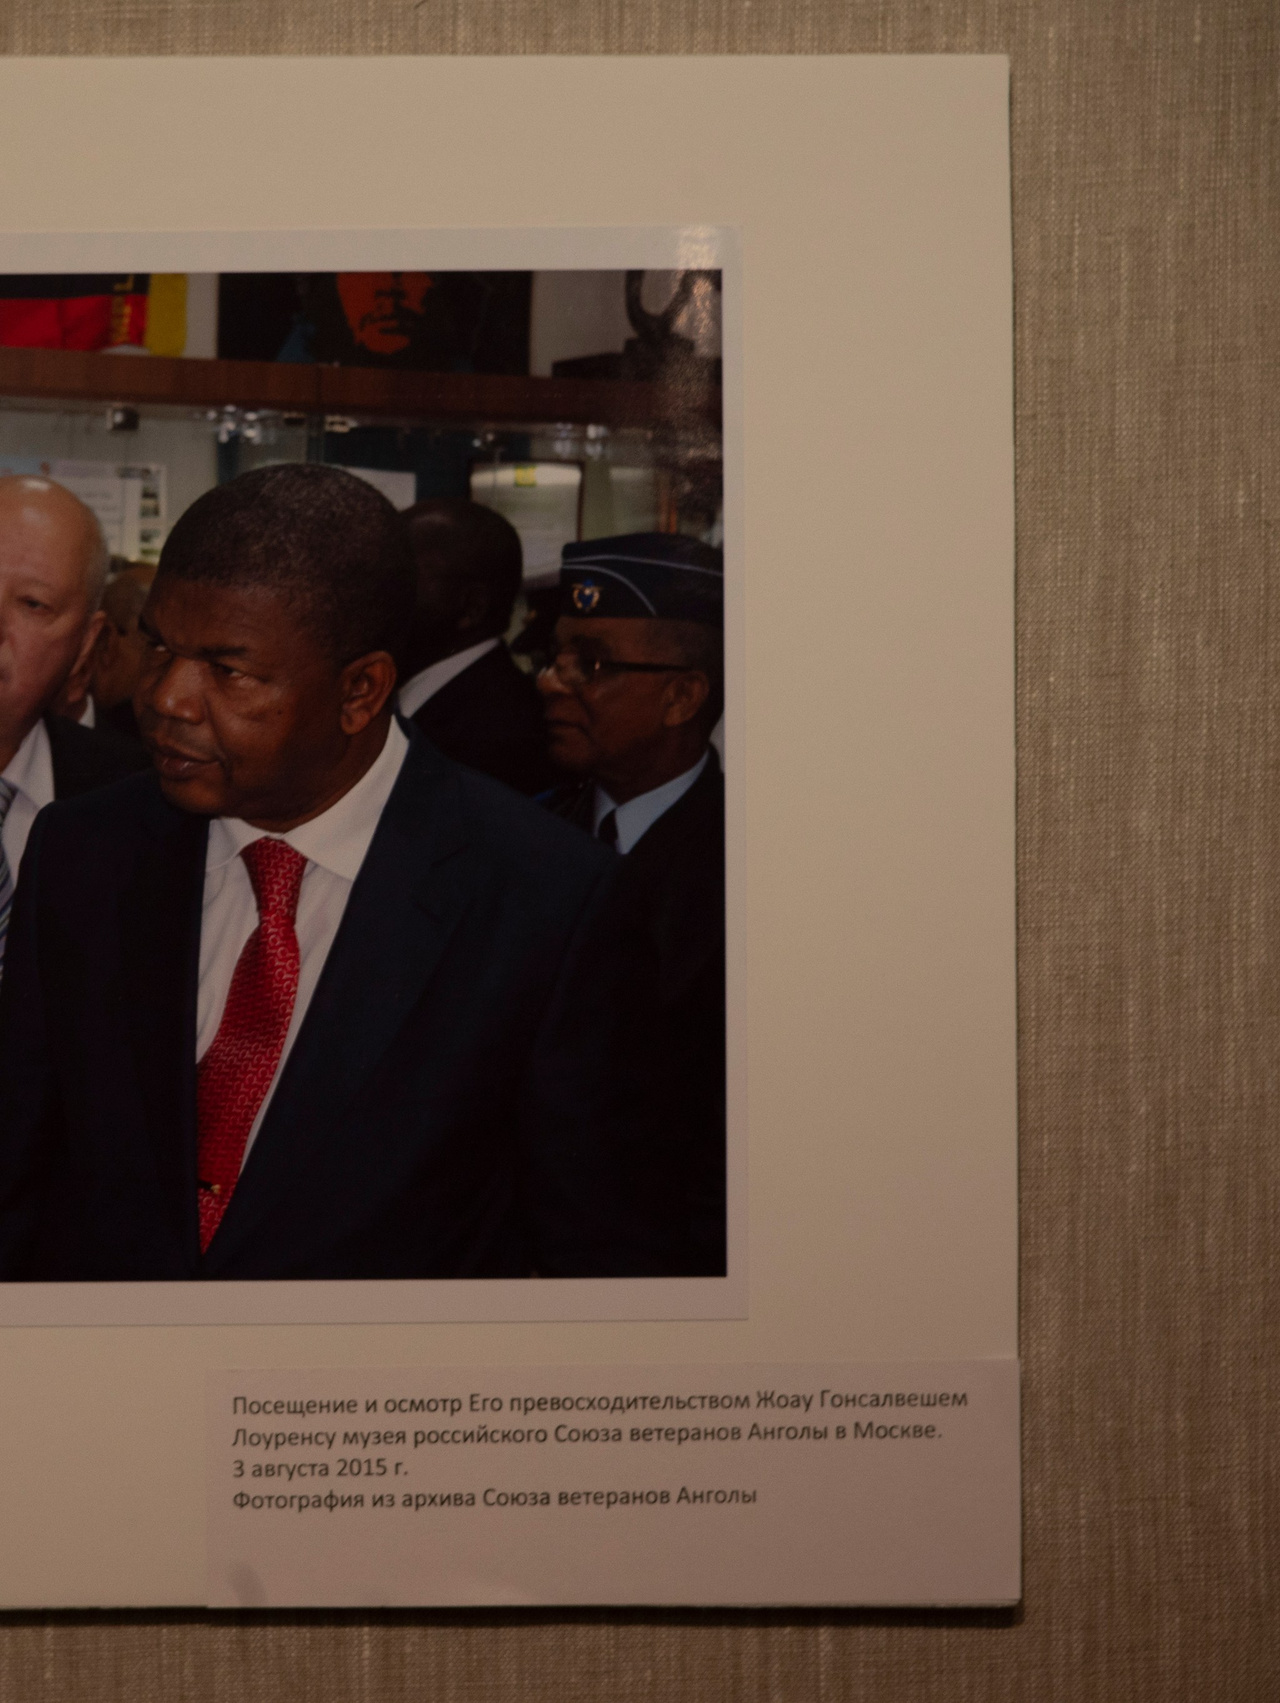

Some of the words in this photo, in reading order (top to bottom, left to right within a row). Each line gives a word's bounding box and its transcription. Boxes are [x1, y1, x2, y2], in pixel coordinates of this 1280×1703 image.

[232, 1396, 358, 1418] Посещение
[364, 1399, 378, 1414] и
[383, 1397, 463, 1417] осмотр
[469, 1393, 504, 1413] Его
[509, 1394, 751, 1416] превосходительством
[756, 1390, 814, 1413] Жоау
[820, 1389, 968, 1409] Гонсалвешем
[231, 1428, 337, 1451] Лоуренсу
[342, 1430, 407, 1449] музея
[413, 1424, 549, 1449] российского
[554, 1423, 623, 1443] Союза
[629, 1426, 742, 1446] ветеранов
[747, 1422, 829, 1441] Анголы
[835, 1425, 847, 1440] в
[853, 1421, 942, 1440] Москве.
[233, 1459, 245, 1479] 3
[251, 1462, 330, 1482] августа
[336, 1457, 388, 1477] 2015
[394, 1461, 408, 1476] г.
[232, 1489, 365, 1513] Фотография
[371, 1493, 396, 1508] из
[401, 1492, 476, 1512] архива
[482, 1487, 551, 1507] Союза
[557, 1490, 671, 1510] ветеранов
[675, 1485, 757, 1505] Анголы
